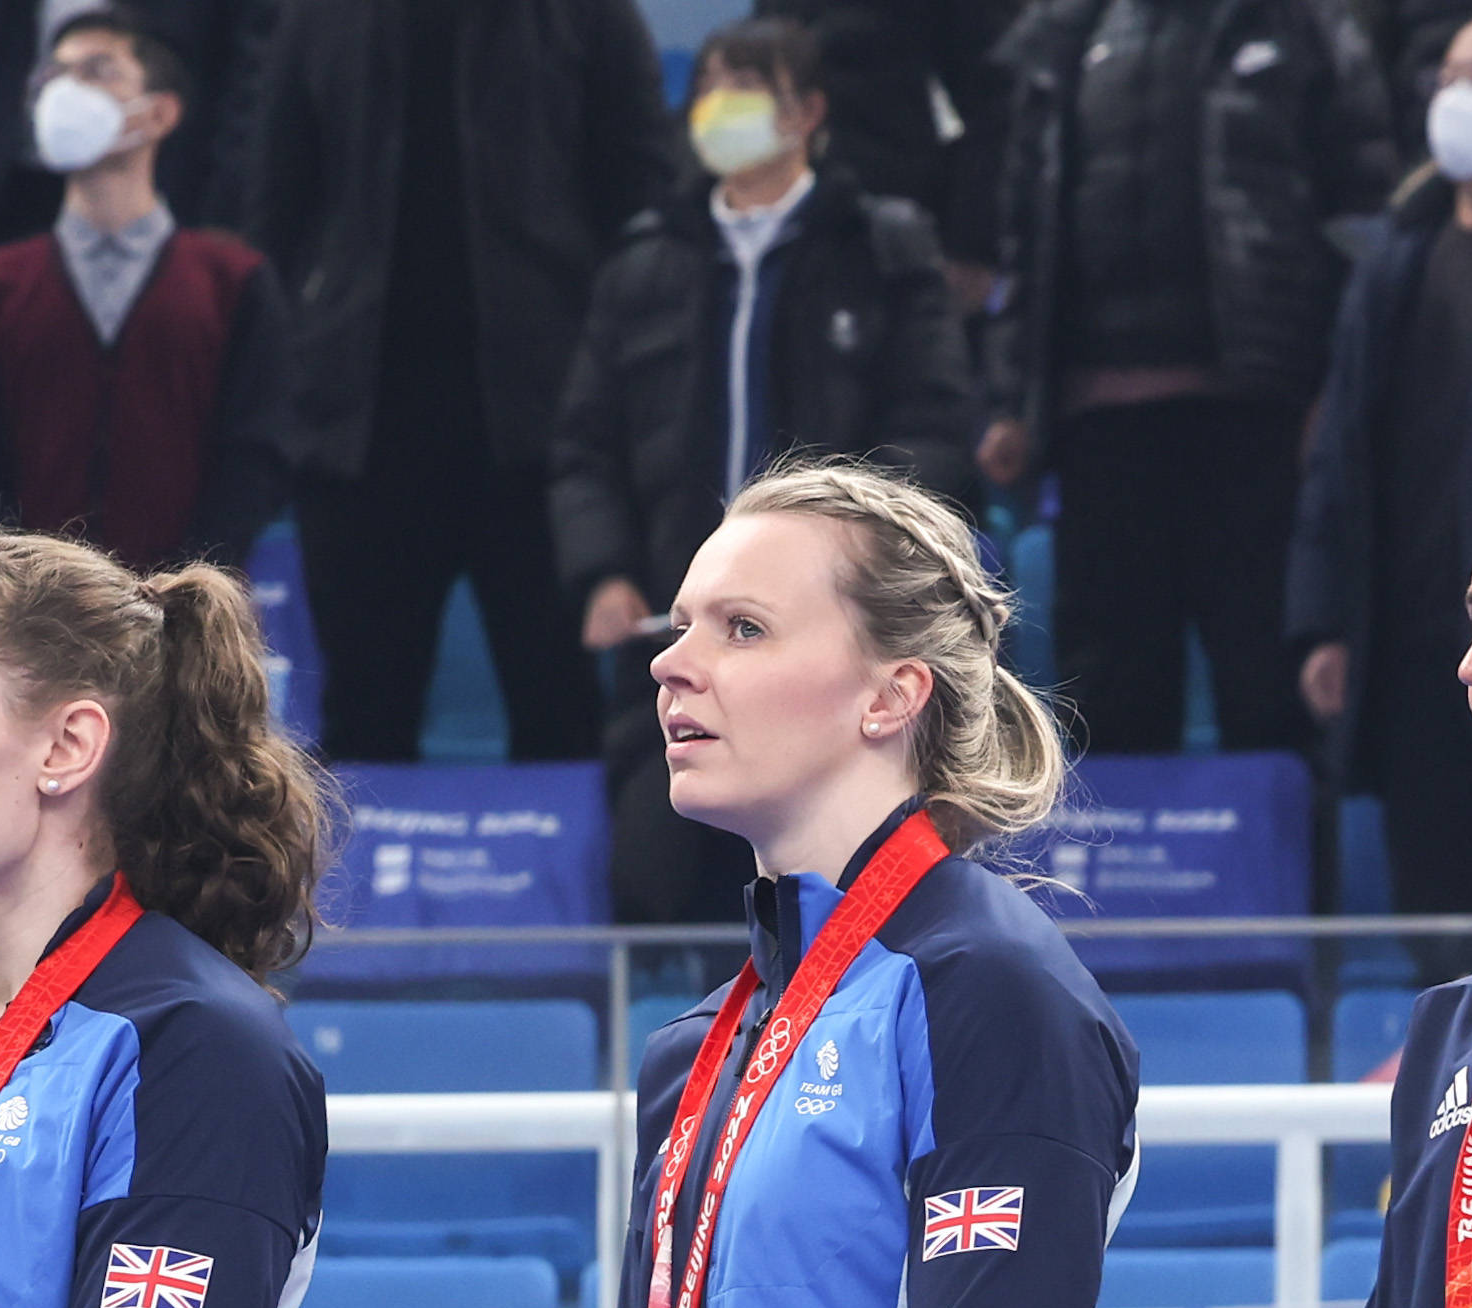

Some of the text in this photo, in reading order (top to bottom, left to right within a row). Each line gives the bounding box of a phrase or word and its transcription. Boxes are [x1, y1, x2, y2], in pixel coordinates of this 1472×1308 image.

[799, 1082, 831, 1096] TEAM
[2, 1135, 22, 1147] GB
[713, 1090, 756, 1184] 2022
